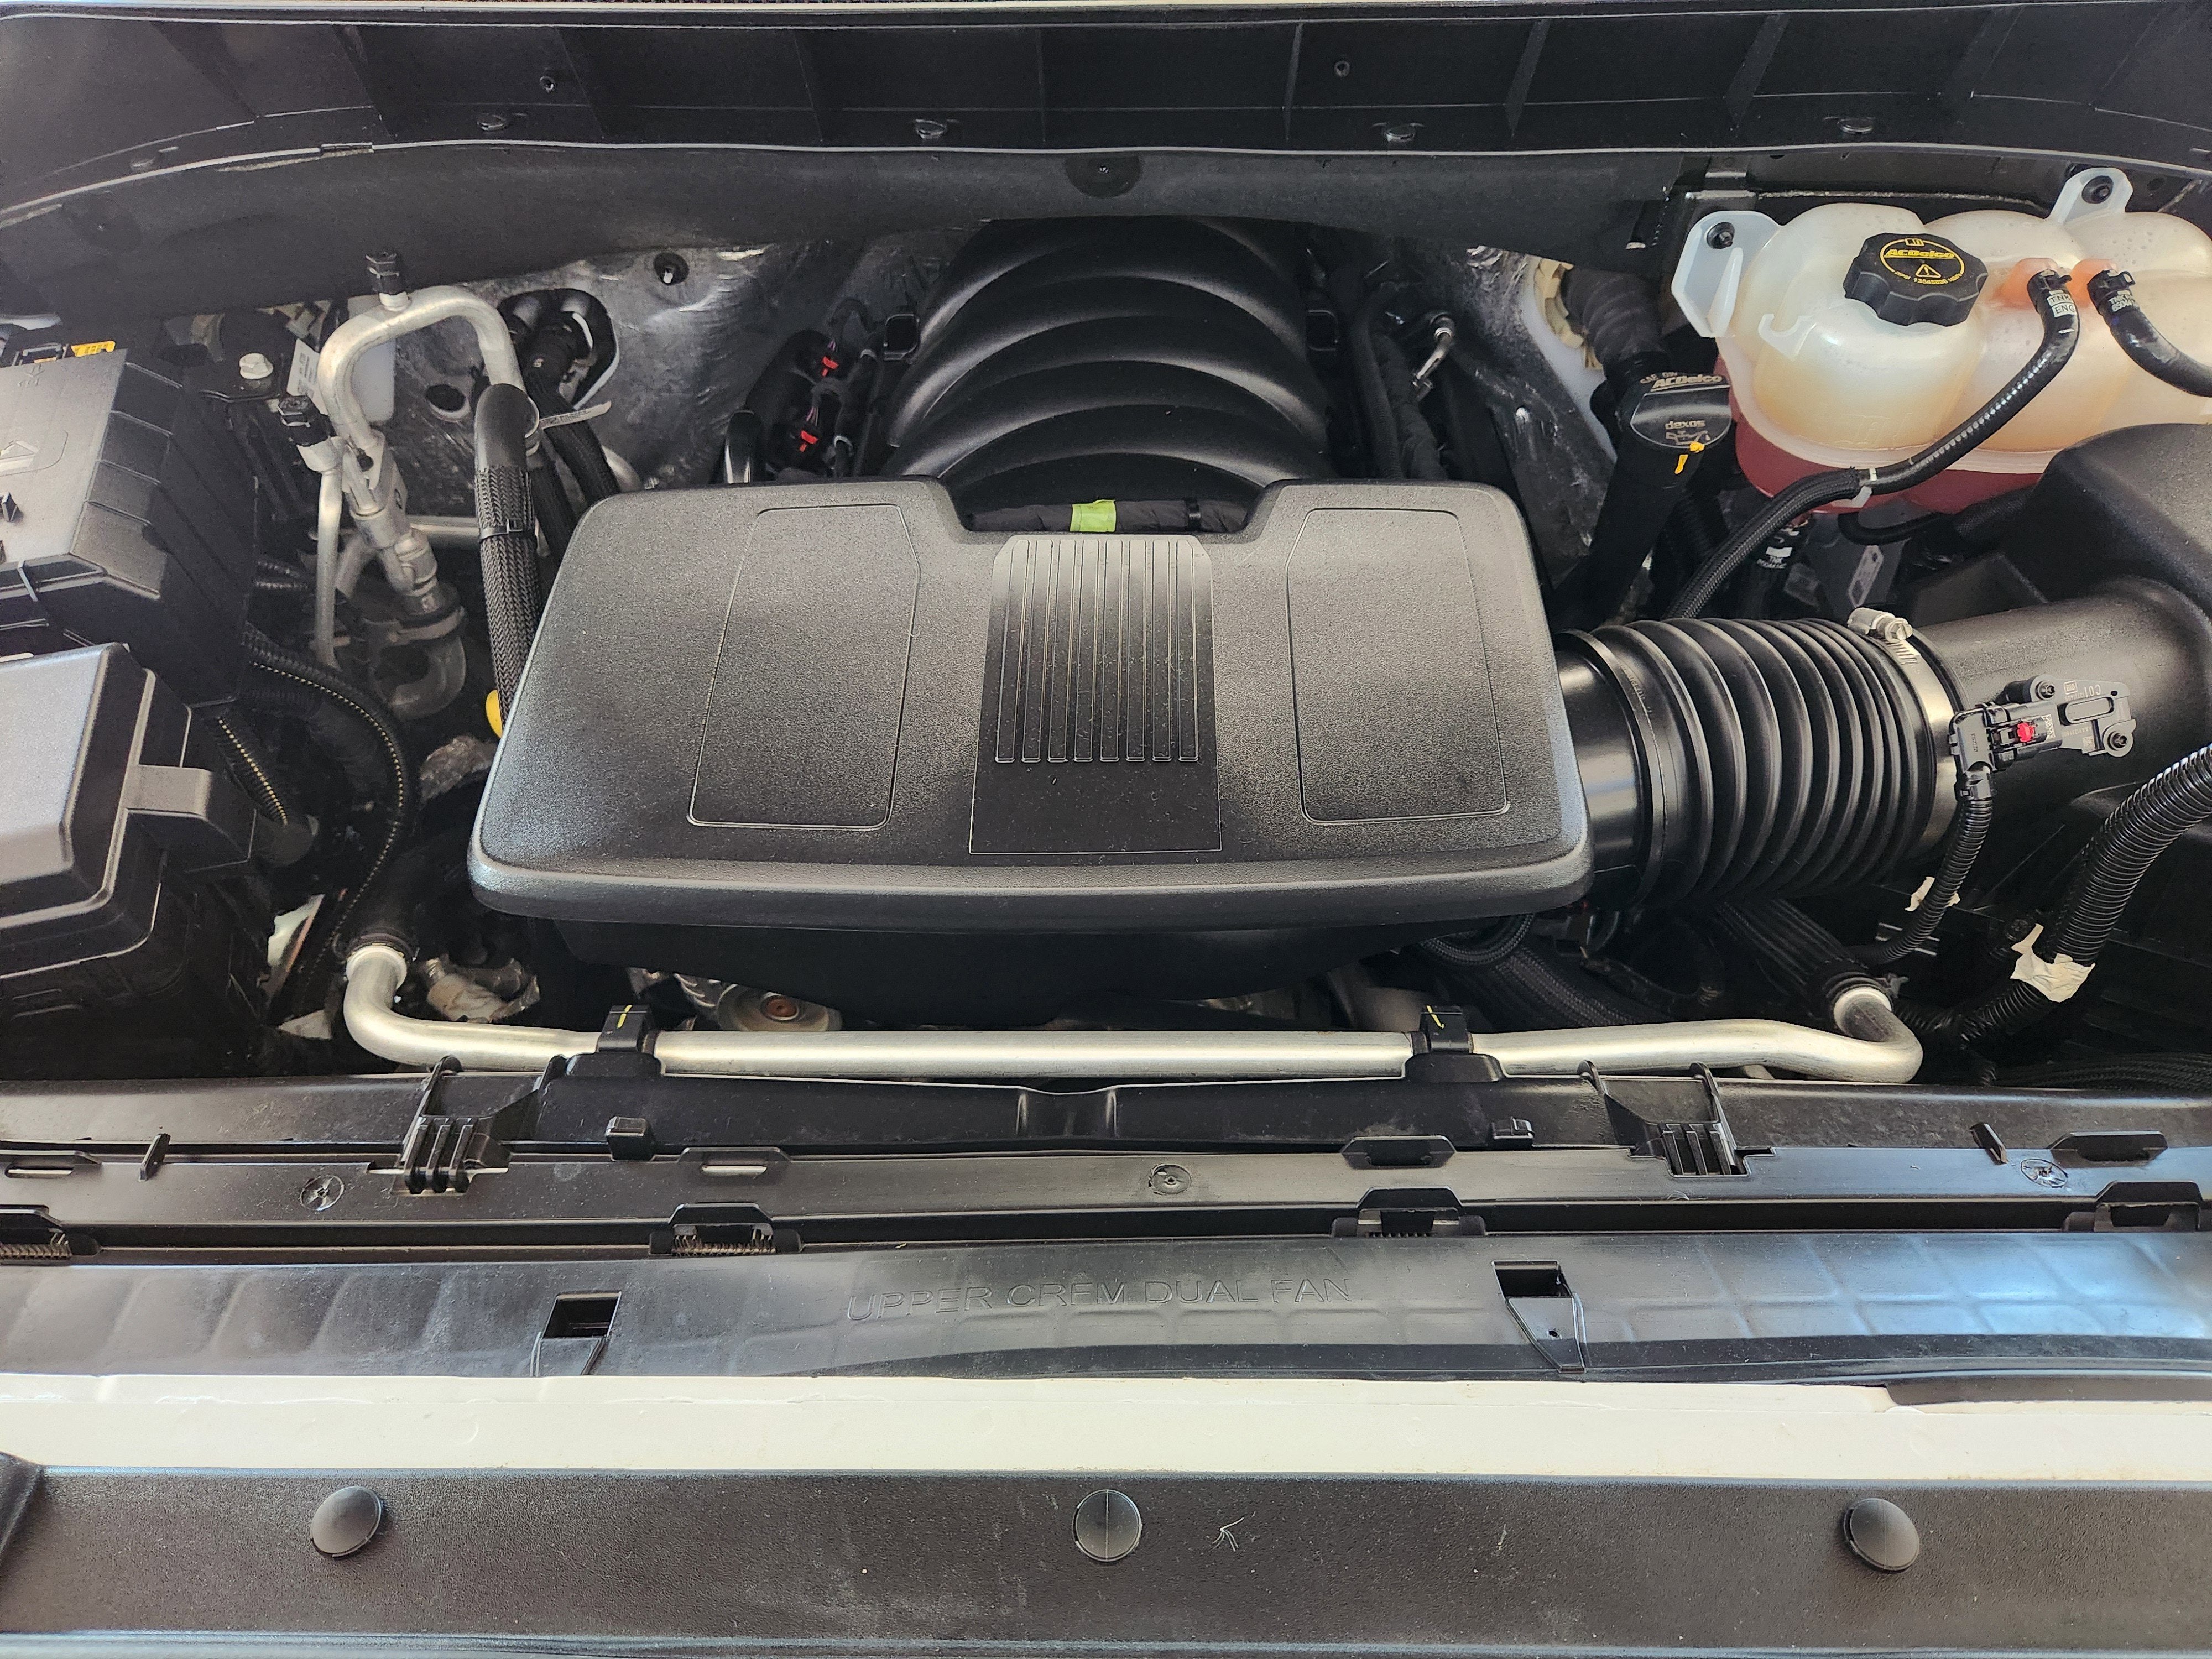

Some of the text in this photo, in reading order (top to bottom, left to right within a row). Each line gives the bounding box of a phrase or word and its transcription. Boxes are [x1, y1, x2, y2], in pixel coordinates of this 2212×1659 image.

[1884, 249, 1955, 258] ACDelco
[2054, 304, 2075, 314] ENG
[1652, 374, 1723, 389] ACDelco
[1665, 420, 1706, 430] dexos
[847, 1279, 1353, 1321] UPPER CRFM DUAL FAN
